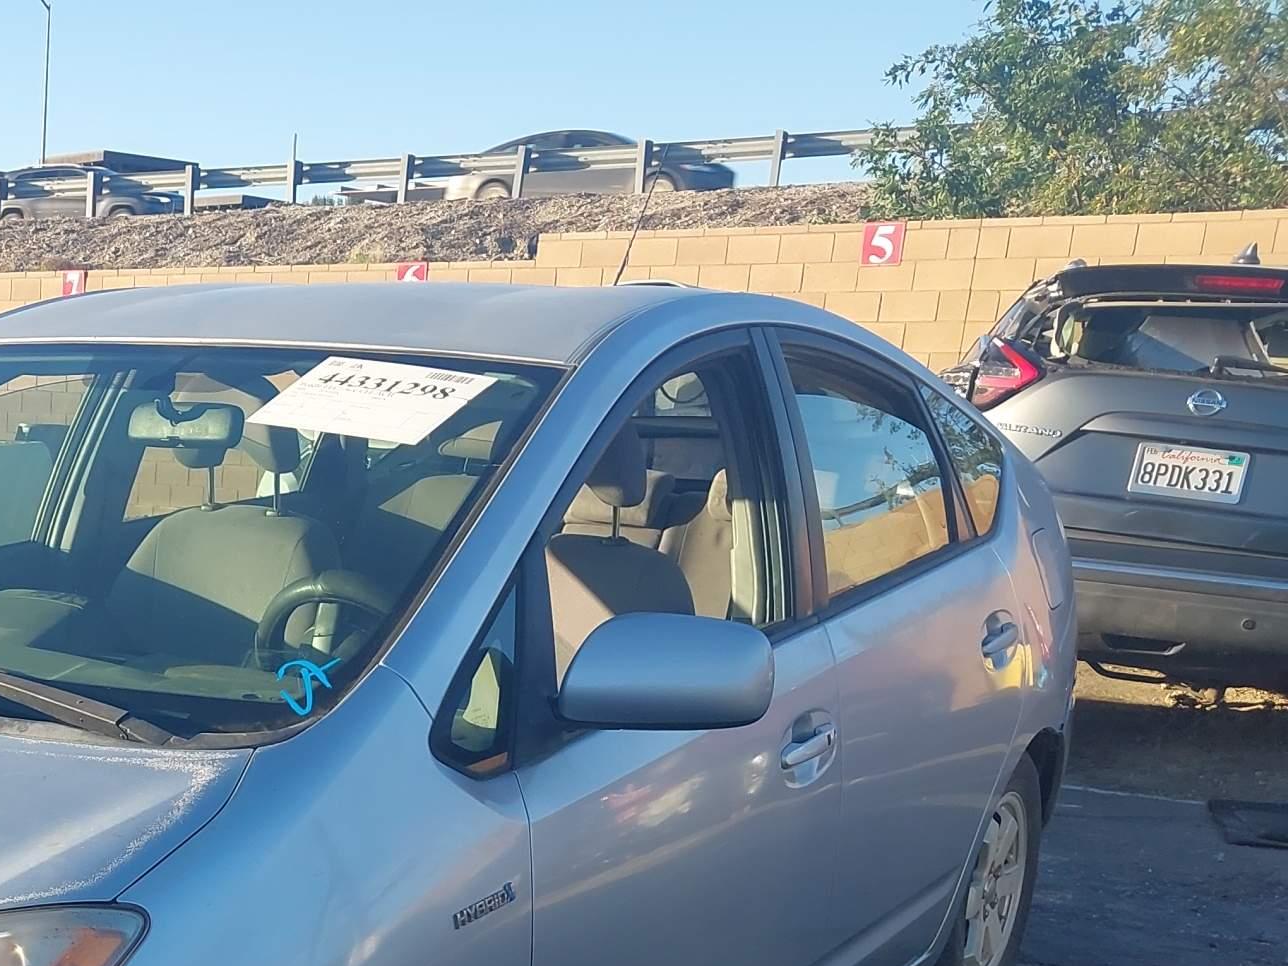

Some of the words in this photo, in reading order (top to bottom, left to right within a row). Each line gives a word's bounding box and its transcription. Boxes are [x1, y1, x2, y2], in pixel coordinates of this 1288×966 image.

[868, 225, 896, 264] 5
[66, 271, 80, 295] 7
[318, 372, 456, 400] 44331298
[1160, 448, 1224, 465] California
[1139, 461, 1235, 495] 8PDK331
[453, 888, 510, 930] HYBRID
